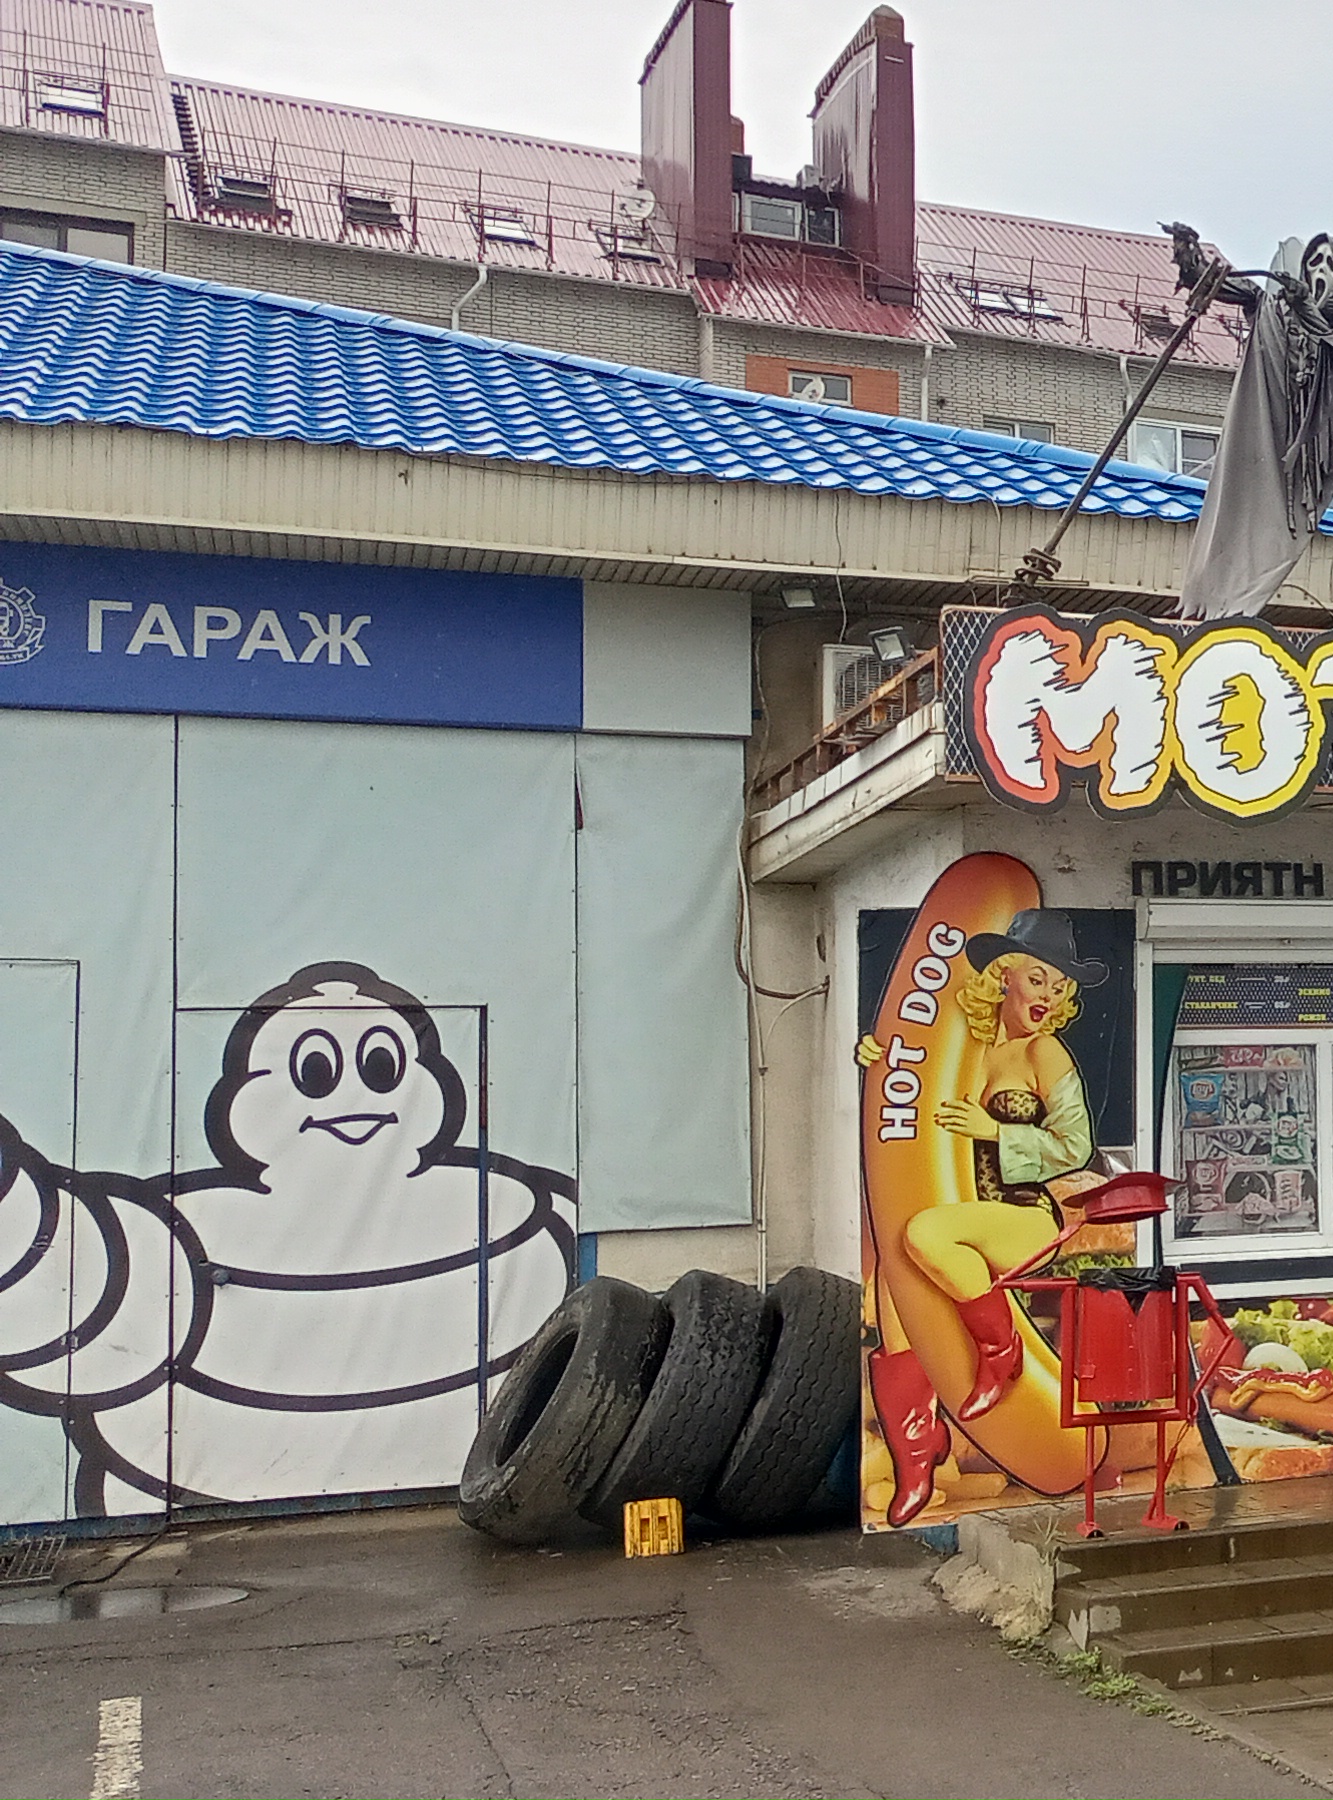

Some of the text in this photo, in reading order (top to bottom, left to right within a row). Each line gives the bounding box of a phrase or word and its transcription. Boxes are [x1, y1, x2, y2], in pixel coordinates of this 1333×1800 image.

[87, 599, 372, 667] ГАРАЖ
[879, 922, 966, 1143] HOT DOG
